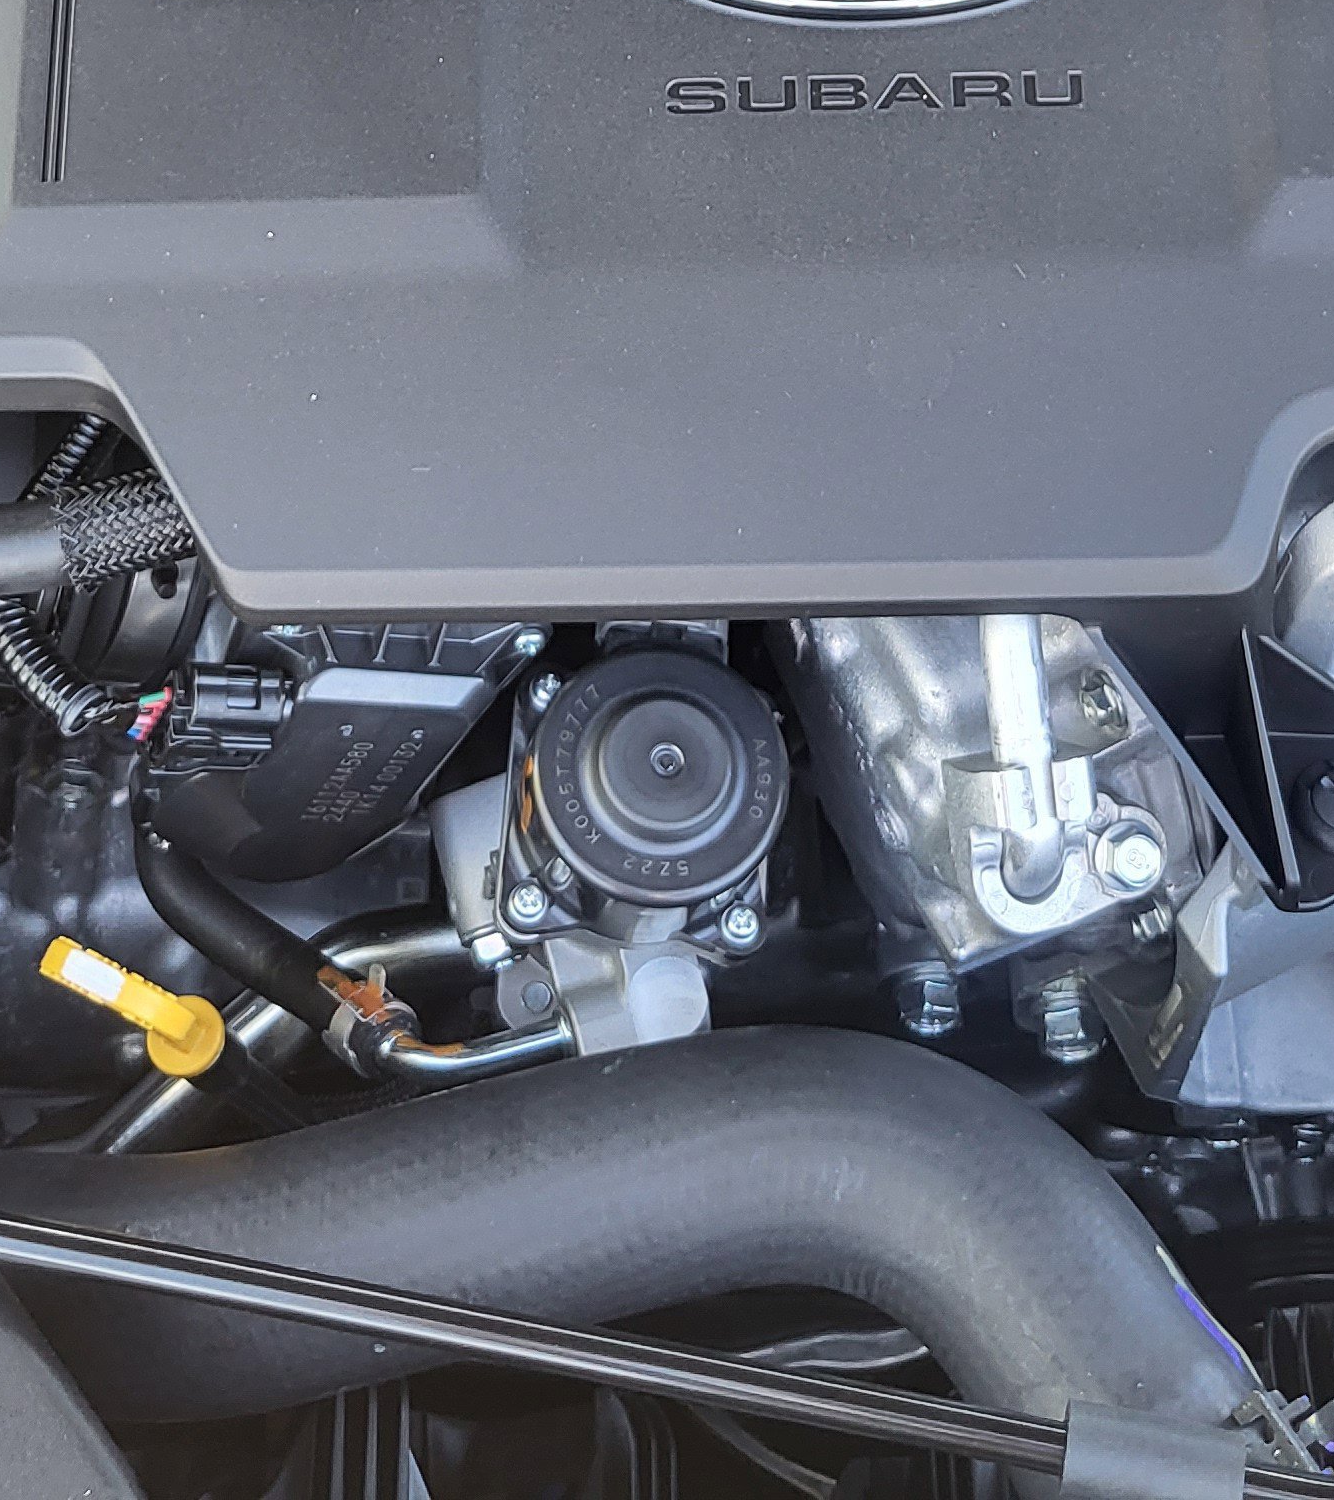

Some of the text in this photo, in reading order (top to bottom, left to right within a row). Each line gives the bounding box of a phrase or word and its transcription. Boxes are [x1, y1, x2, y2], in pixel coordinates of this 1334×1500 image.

[665, 70, 1085, 116] SUBARU
[556, 683, 602, 845] K005T79777
[752, 737, 773, 820] AA930
